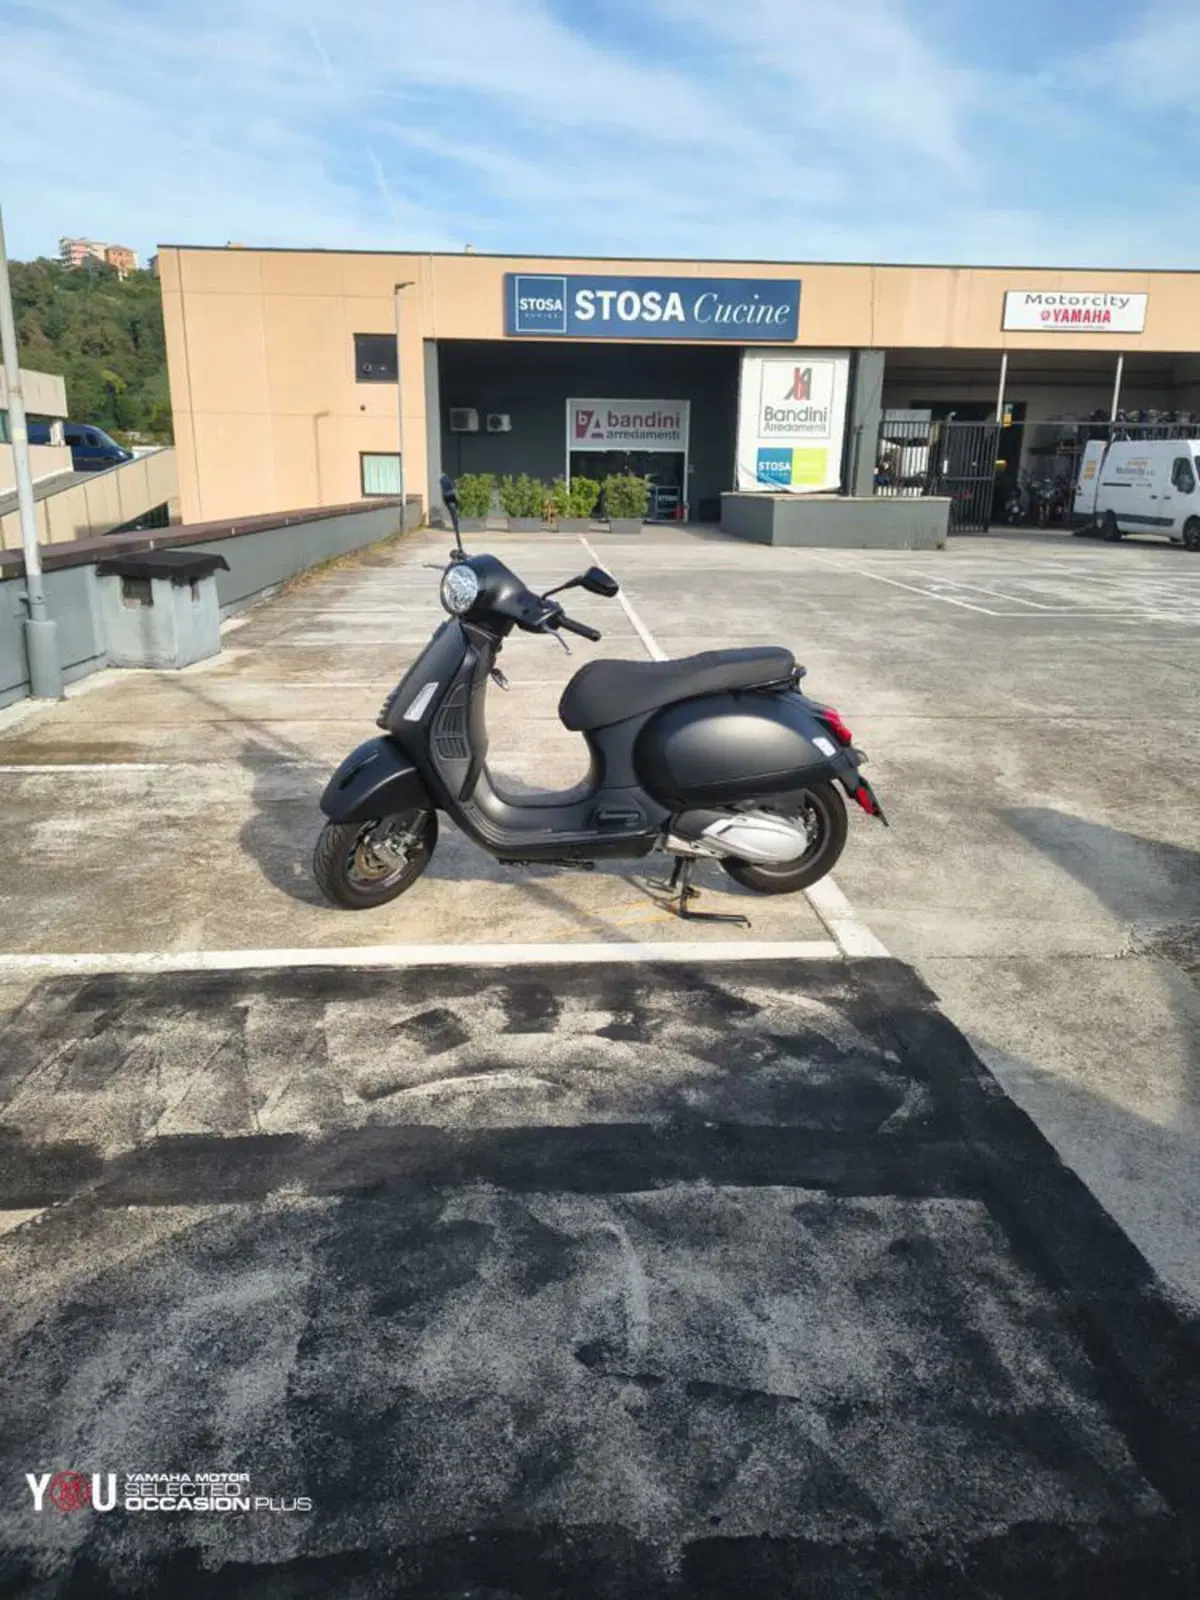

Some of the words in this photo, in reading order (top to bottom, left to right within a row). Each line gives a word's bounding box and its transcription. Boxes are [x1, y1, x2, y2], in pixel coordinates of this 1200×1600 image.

[519, 298, 563, 312] STOSA
[574, 289, 686, 322] STOSA
[693, 292, 790, 324] Cucine
[1024, 294, 1131, 310] Motorcity
[1052, 308, 1112, 323] YAMAHA
[607, 410, 680, 428] bandini
[764, 405, 828, 422] Bandini
[758, 461, 791, 471] STOSA
